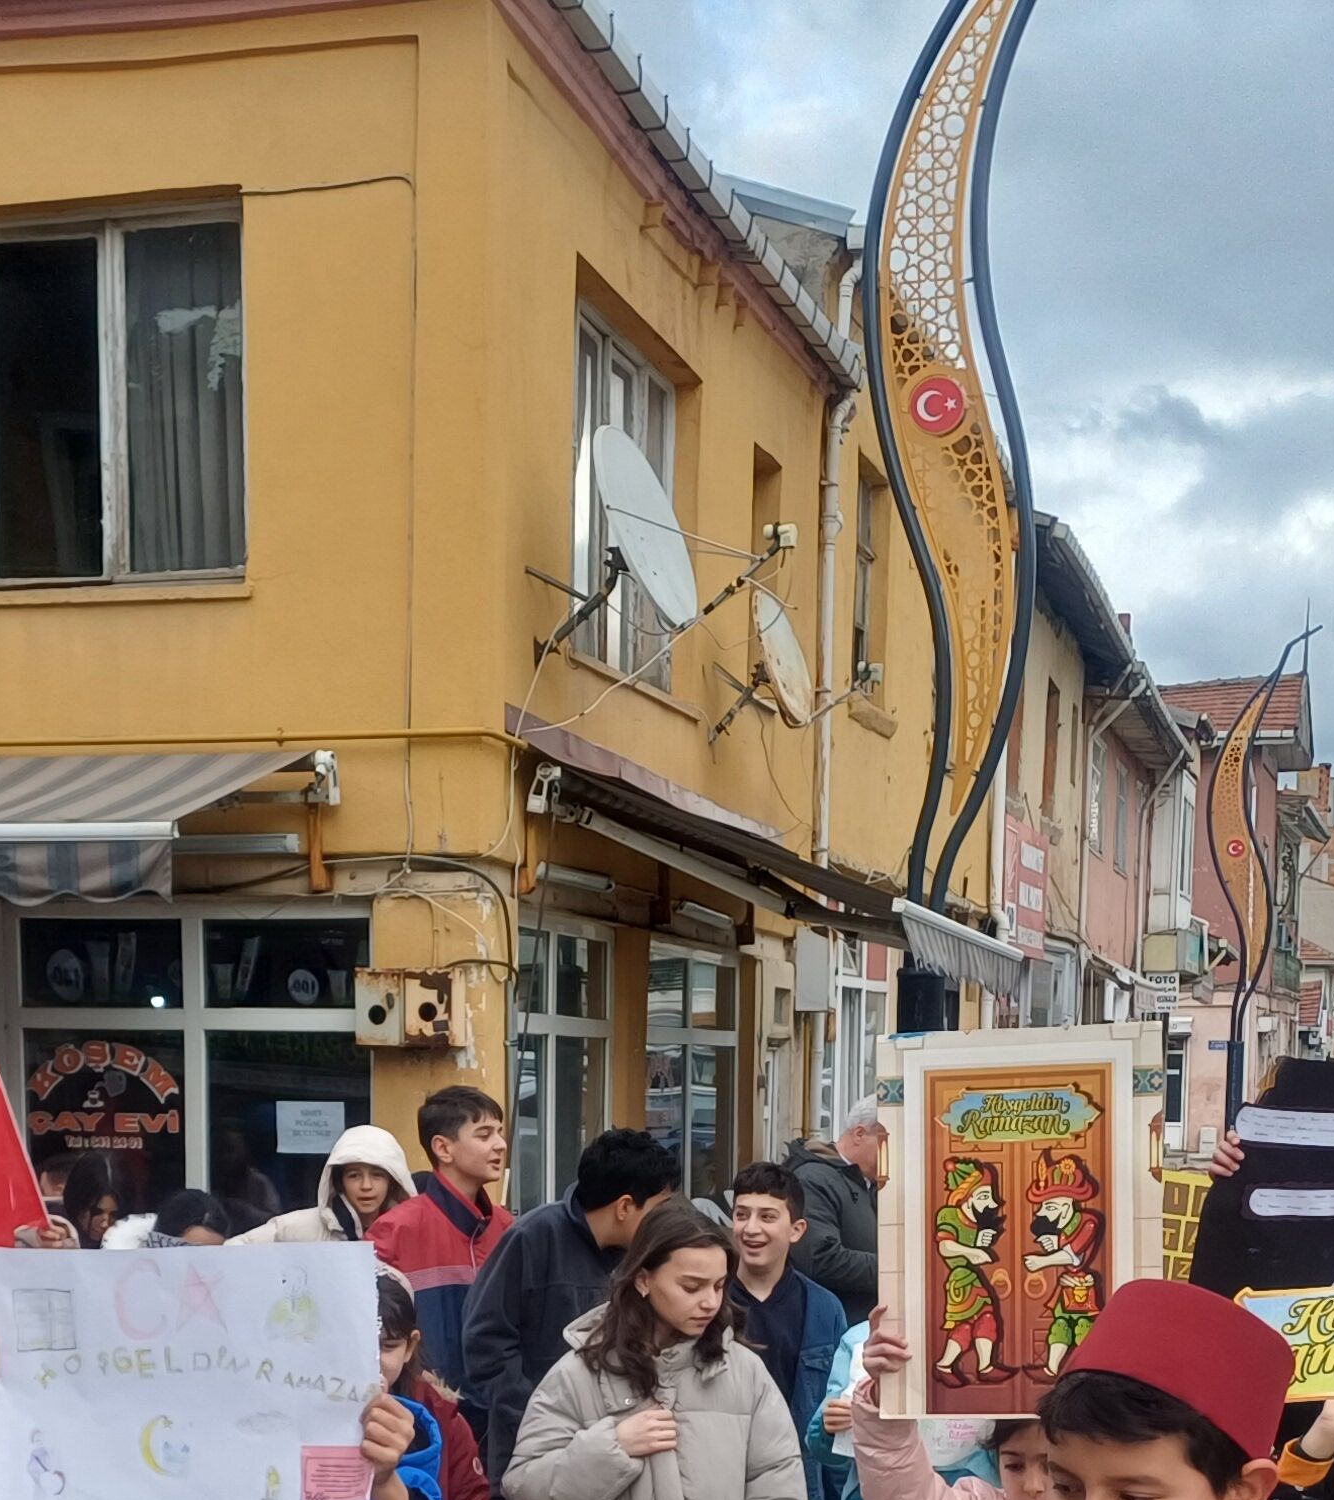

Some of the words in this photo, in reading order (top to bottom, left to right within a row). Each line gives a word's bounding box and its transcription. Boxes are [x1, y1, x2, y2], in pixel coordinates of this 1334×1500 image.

[27, 1040, 180, 1105] KÖŞEM
[27, 1110, 106, 1136] ÇAY
[114, 1109, 180, 1134] EVİ
[957, 1108, 1071, 1140] Ramazan
